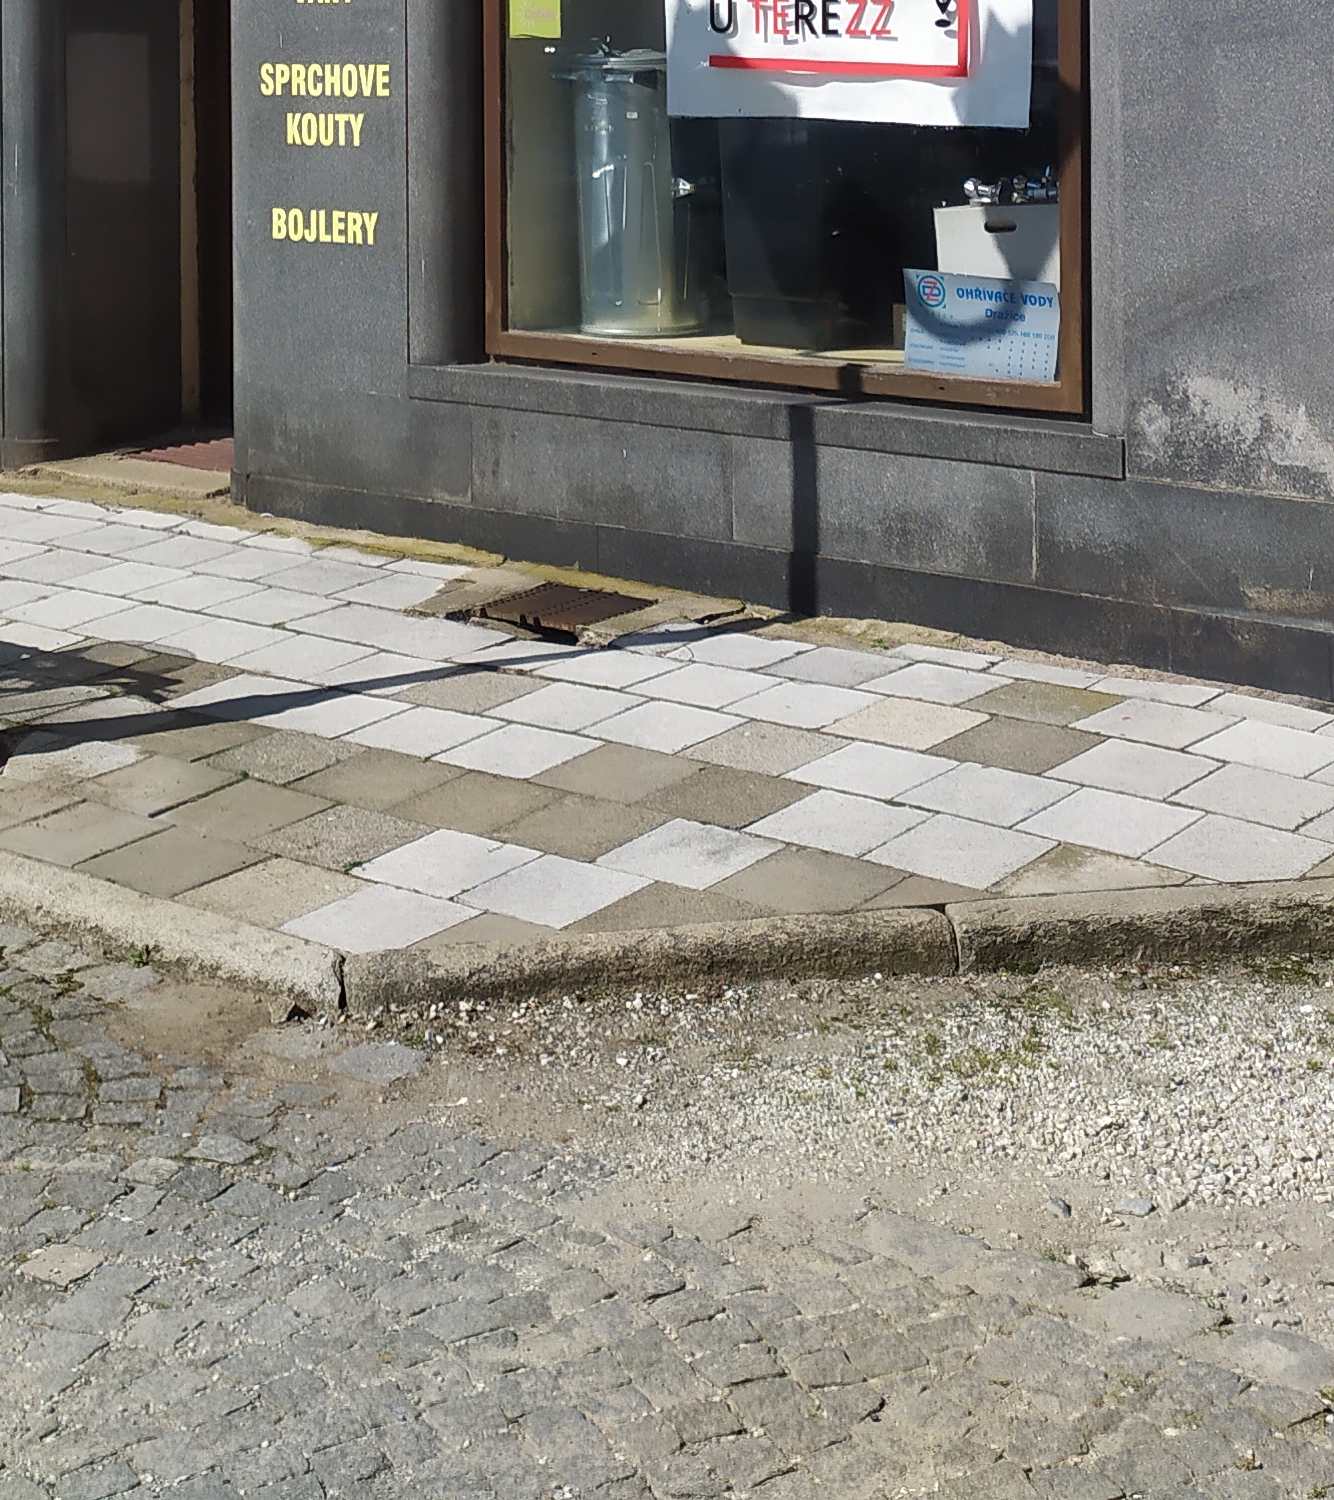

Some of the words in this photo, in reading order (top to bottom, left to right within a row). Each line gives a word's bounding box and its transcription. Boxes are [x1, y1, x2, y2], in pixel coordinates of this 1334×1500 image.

[260, 62, 390, 98] SPRCHOVE
[286, 112, 365, 147] KOUTY
[271, 207, 379, 246] BOJLERY
[985, 308, 1026, 322] Dražice
[1021, 294, 1054, 308] VODY
